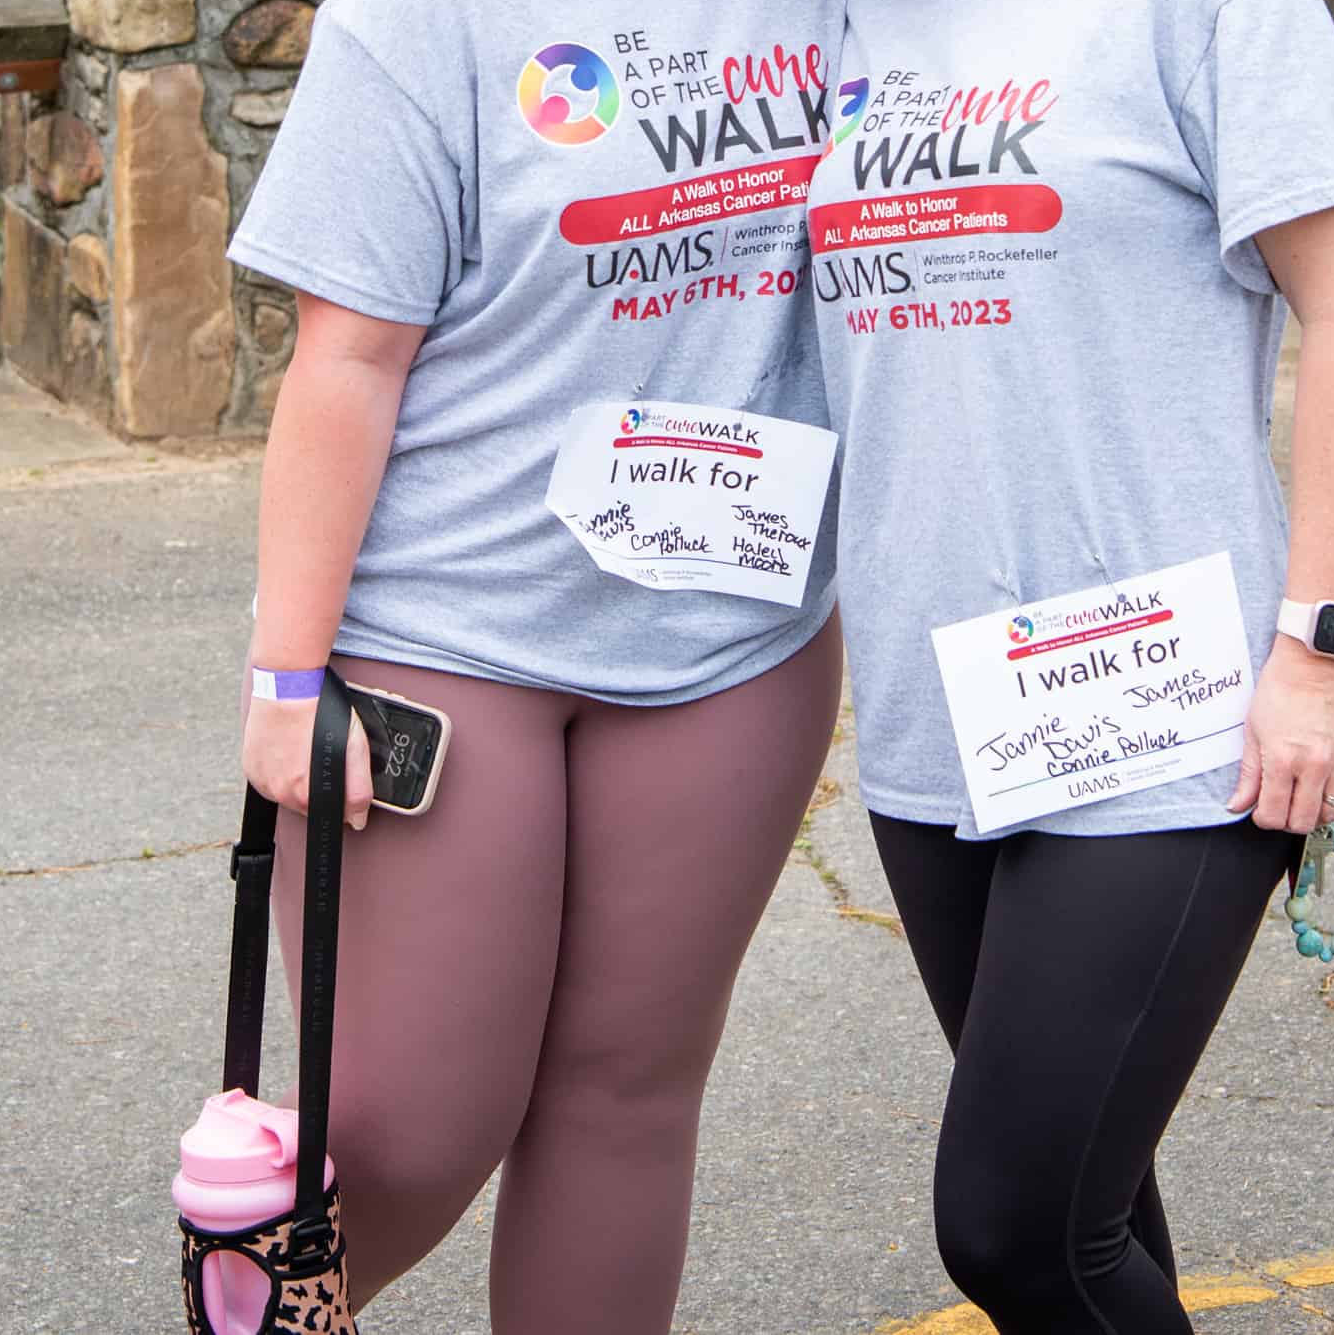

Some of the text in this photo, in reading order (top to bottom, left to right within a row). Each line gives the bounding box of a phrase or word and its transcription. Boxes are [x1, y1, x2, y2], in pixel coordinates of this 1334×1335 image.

[614, 30, 649, 54] BE
[625, 50, 709, 81] A PART
[631, 43, 829, 108] OF THE cure
[883, 70, 921, 87] BE
[863, 78, 1060, 134] OF THE cure
[870, 84, 952, 107] A PART
[637, 87, 831, 173] WALK
[853, 120, 1046, 191] WALK
[671, 168, 785, 205] A Walk to Honor
[620, 214, 653, 235] ALL
[658, 201, 721, 227] Arkansas
[723, 190, 777, 212] Cancer
[860, 195, 958, 221] A Walk to Honor
[735, 223, 795, 242] Winthrop
[824, 210, 1008, 246] ALL Arkansas Cancer Patients
[731, 242, 776, 258] Cancer
[922, 250, 966, 267] Winthrop
[978, 247, 1058, 262] Rockefeller
[923, 267, 1005, 285] Cancer Institute
[612, 288, 679, 322] MAY
[682, 273, 746, 305] 6TH,
[889, 301, 945, 332] 6TH,
[950, 298, 1012, 327] 2023
[698, 421, 761, 445] WALK
[610, 456, 760, 493] I walk for
[731, 504, 789, 530] James
[1098, 590, 1164, 621] WALK
[1017, 636, 1181, 698] I walk for
[1123, 668, 1207, 708] James
[1171, 669, 1243, 711] Theroux
[385, 731, 411, 778] 9:22
[1043, 714, 1121, 761] Davis
[1067, 773, 1121, 799] UAMS
